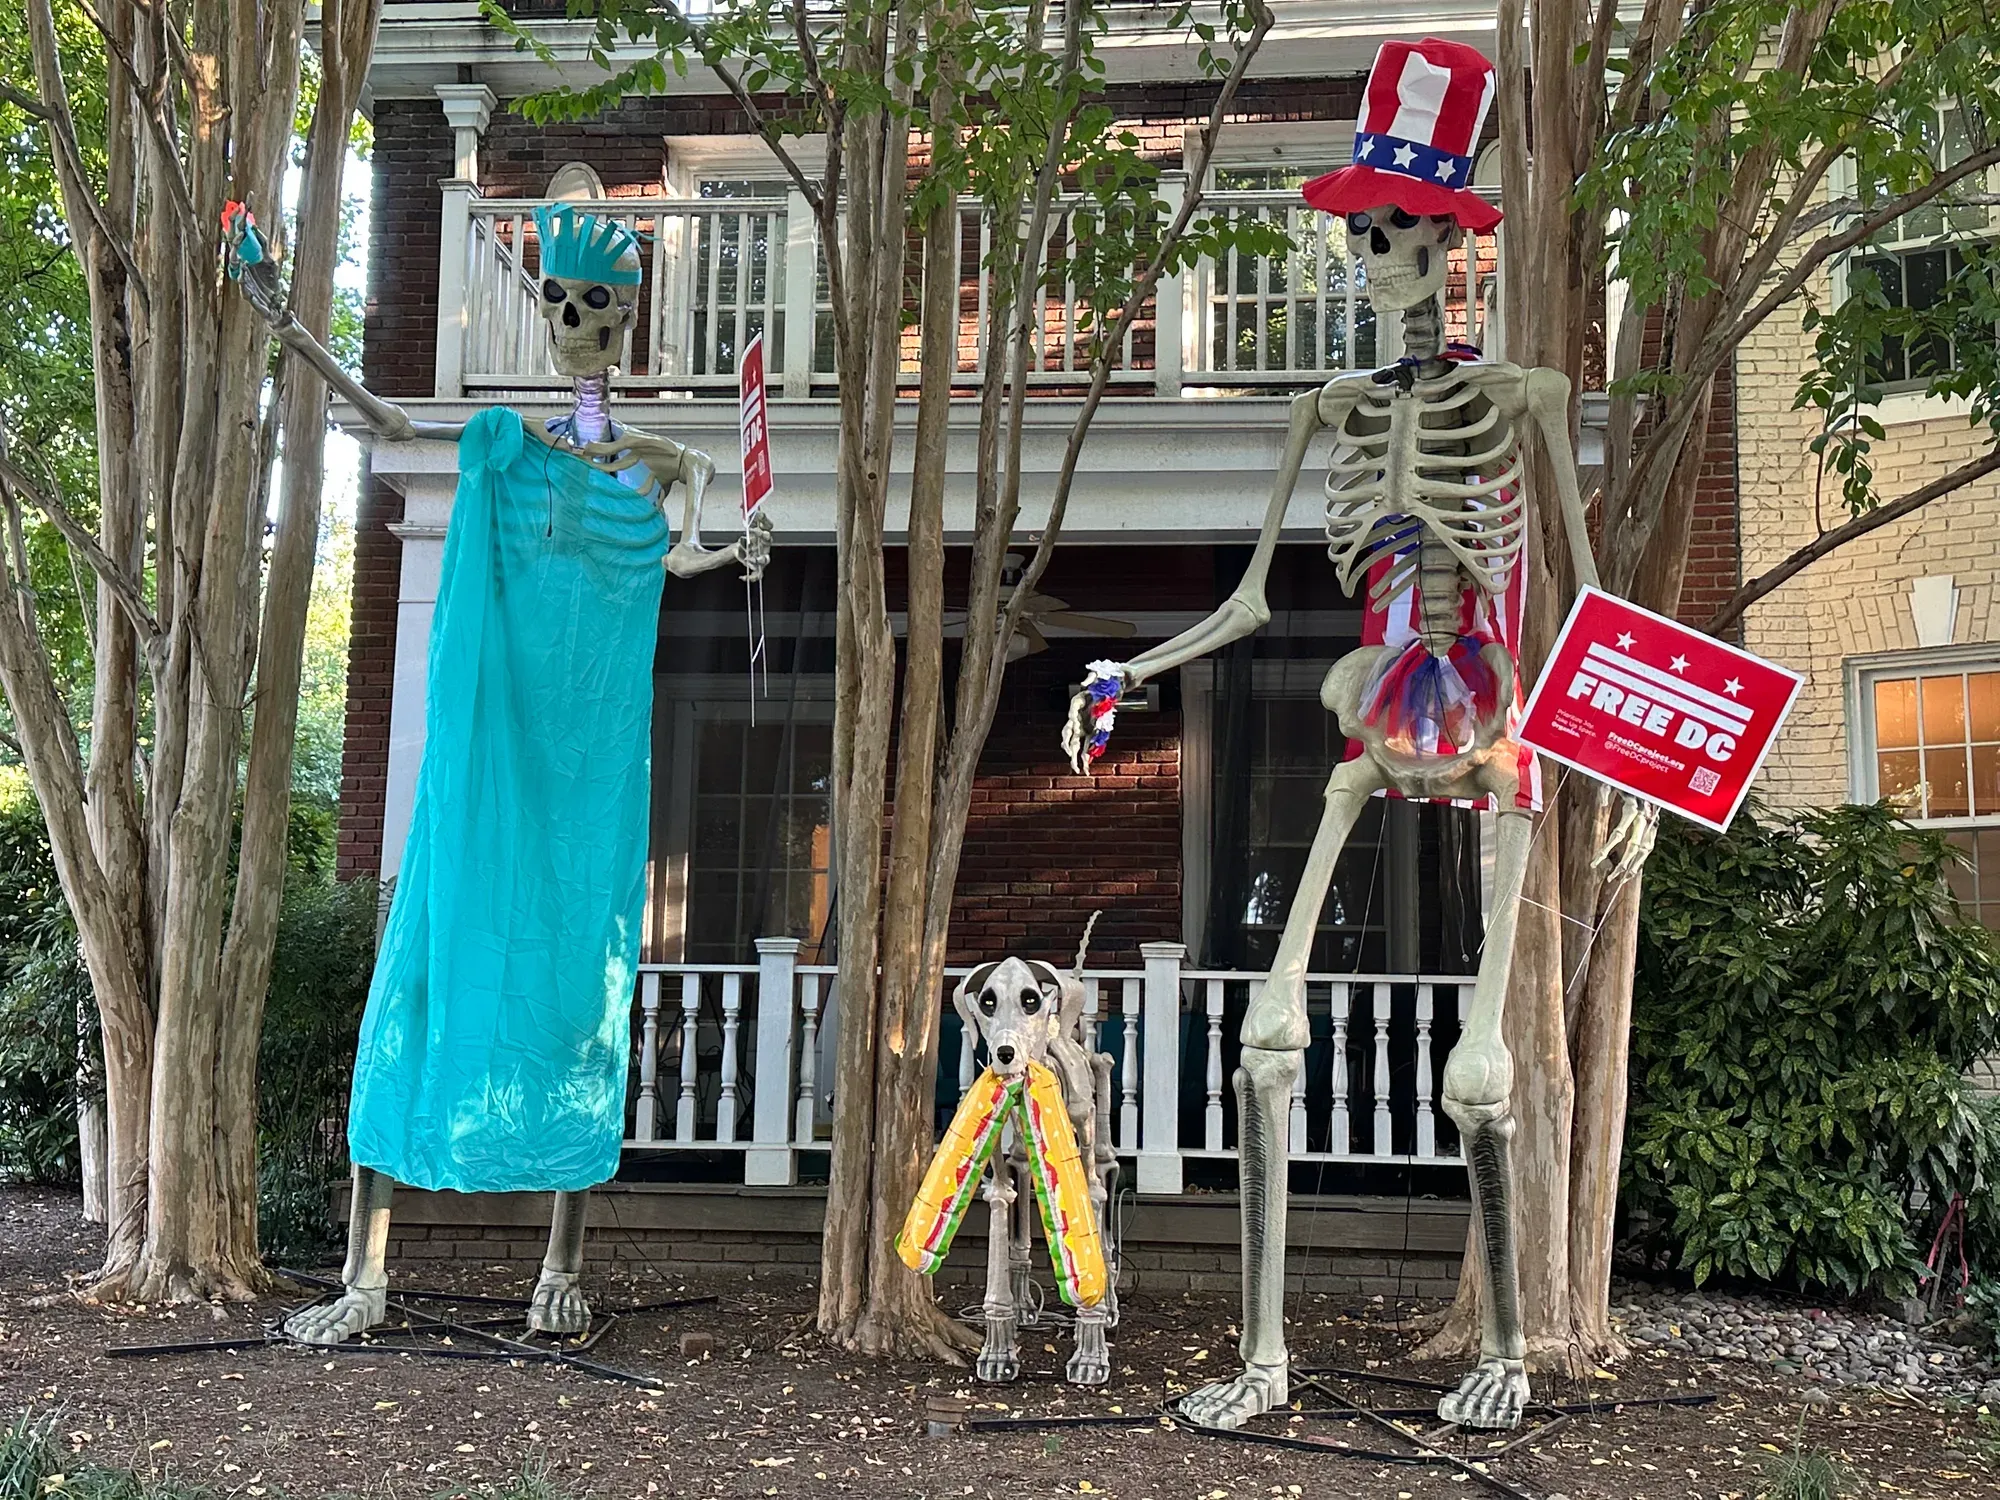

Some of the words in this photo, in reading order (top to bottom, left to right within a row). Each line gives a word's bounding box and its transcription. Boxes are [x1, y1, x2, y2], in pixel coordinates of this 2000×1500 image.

[750, 414, 763, 449] DC
[1566, 671, 1675, 737] FREE
[1674, 717, 1737, 762] DC
[1604, 740, 1670, 774] @FreeDCproject
[1607, 731, 1686, 771] FreeDCproject.org
